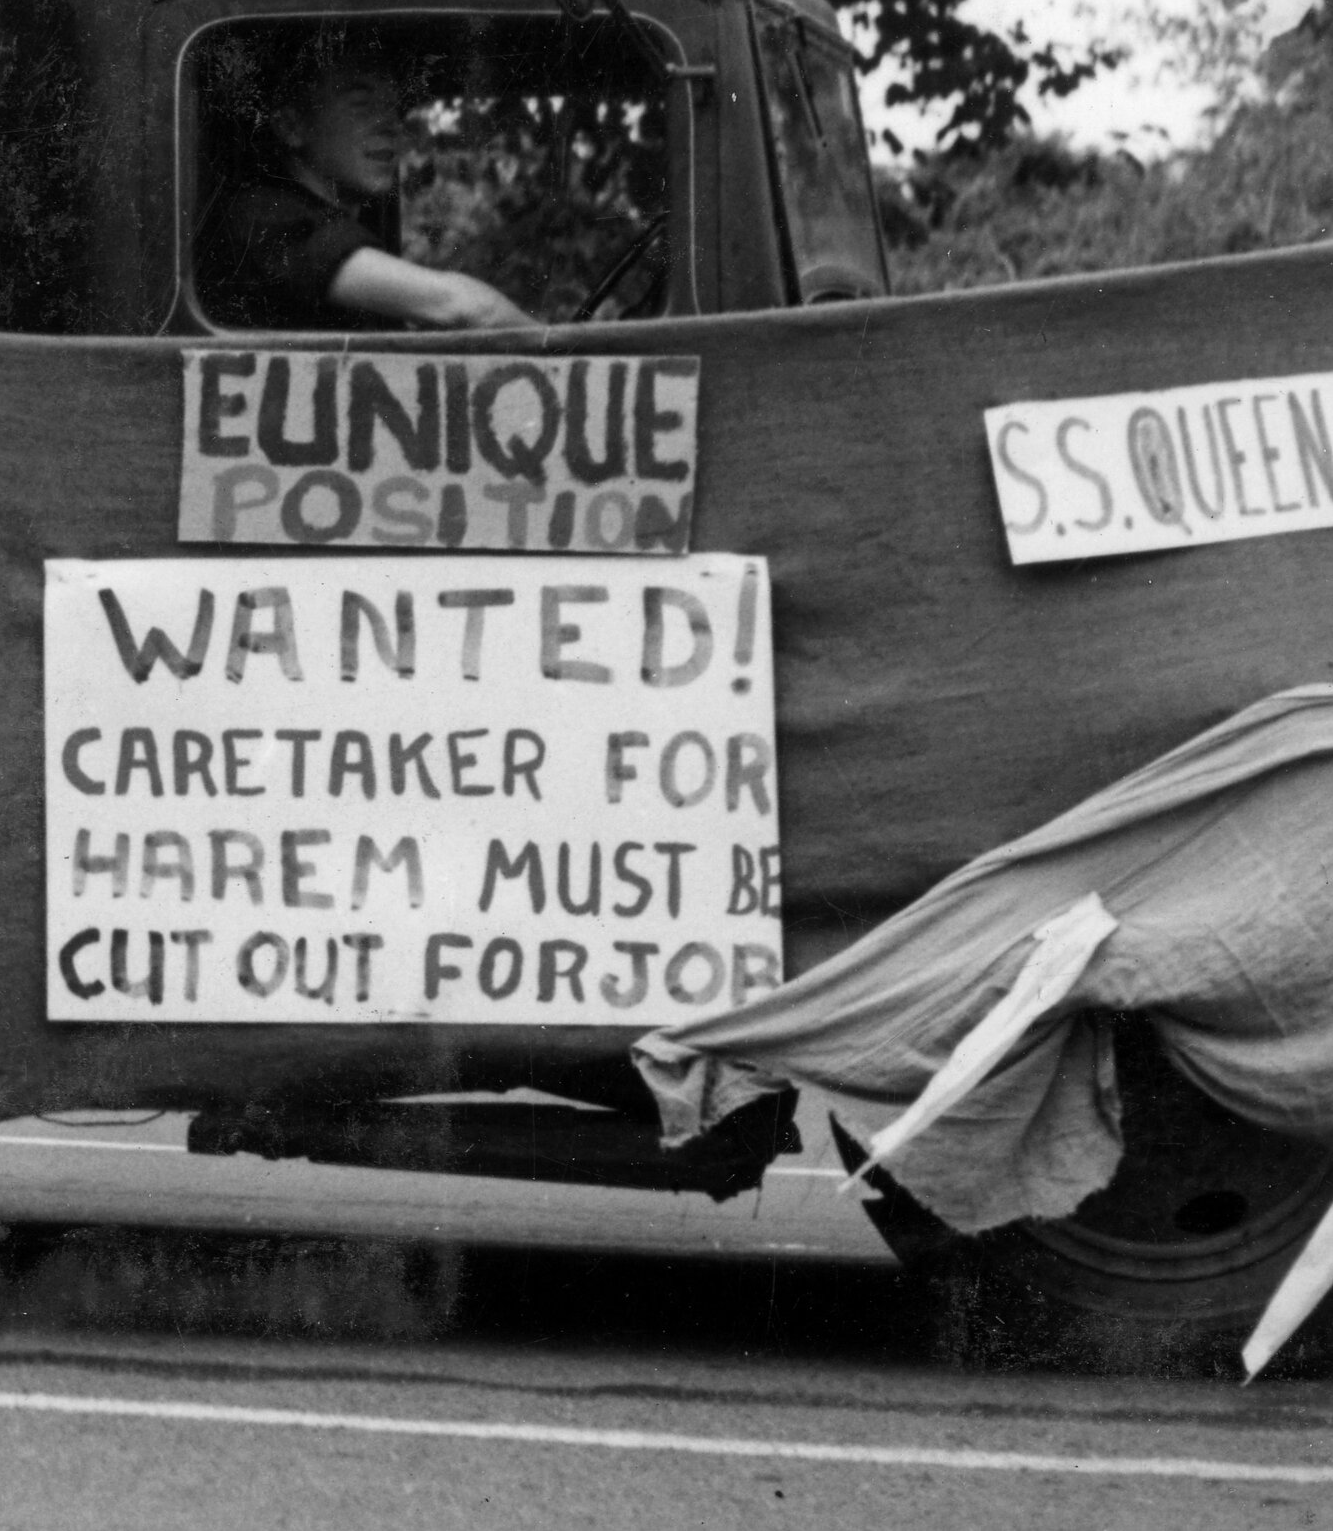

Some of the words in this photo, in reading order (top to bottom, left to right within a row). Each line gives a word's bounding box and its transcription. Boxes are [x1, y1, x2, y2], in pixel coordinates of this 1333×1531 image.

[197, 353, 699, 487] EUNIQUE
[211, 464, 691, 552] POSITION
[98, 561, 760, 695] WANTED!
[61, 727, 547, 801] CARETAKER
[606, 730, 771, 816] FOR
[71, 827, 425, 911] HAREM
[478, 836, 697, 919] MUST
[726, 842, 782, 919] BE
[58, 927, 214, 1007] CUT
[236, 930, 385, 1003] OUT
[424, 933, 589, 1007] FOR
[599, 940, 782, 1009] JOB
